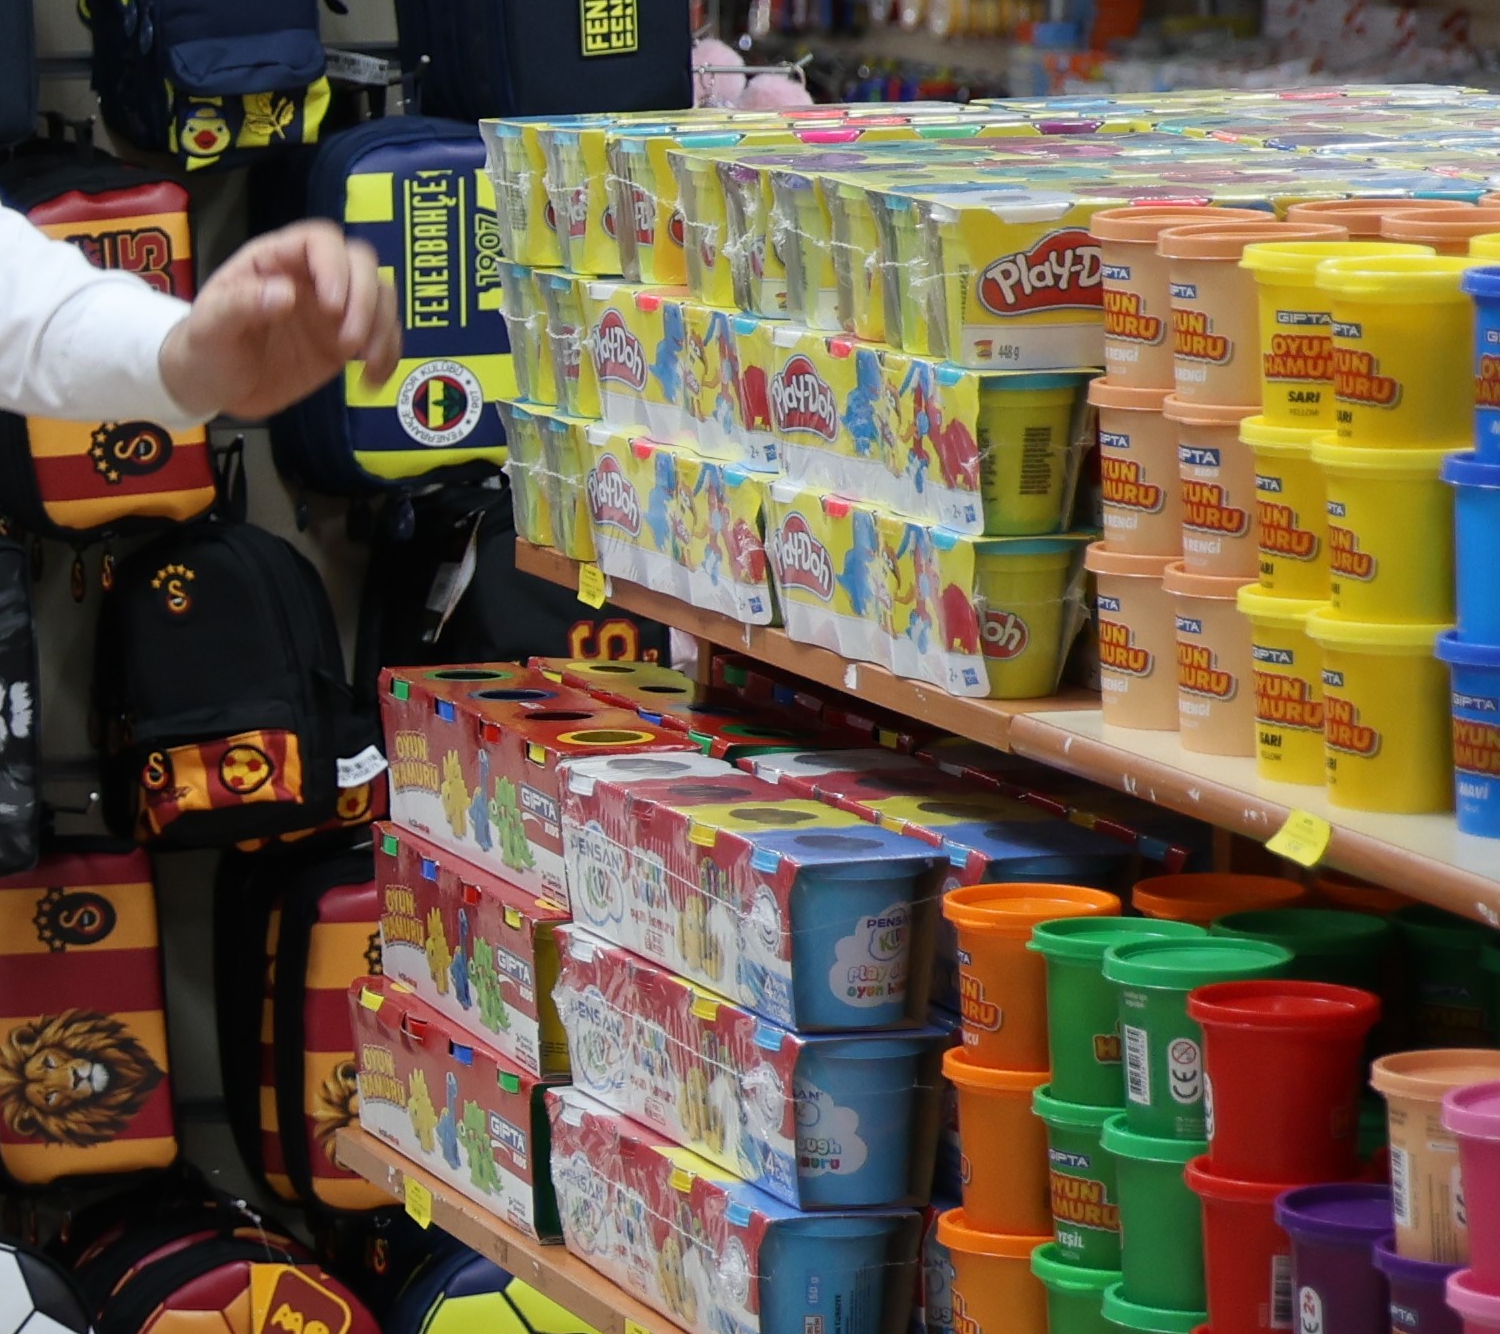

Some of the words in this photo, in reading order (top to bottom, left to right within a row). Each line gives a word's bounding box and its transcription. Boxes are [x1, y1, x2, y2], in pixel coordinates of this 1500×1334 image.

[987, 244, 1103, 303] Play-D
[400, 376, 418, 406] SPOR
[773, 375, 836, 431] Play-Doh
[587, 470, 639, 524] Play-Doh
[774, 536, 831, 593] Play-Doh
[520, 787, 558, 822] GIPTA
[497, 948, 532, 985] GIPTA
[490, 1114, 527, 1153] GIPTA
